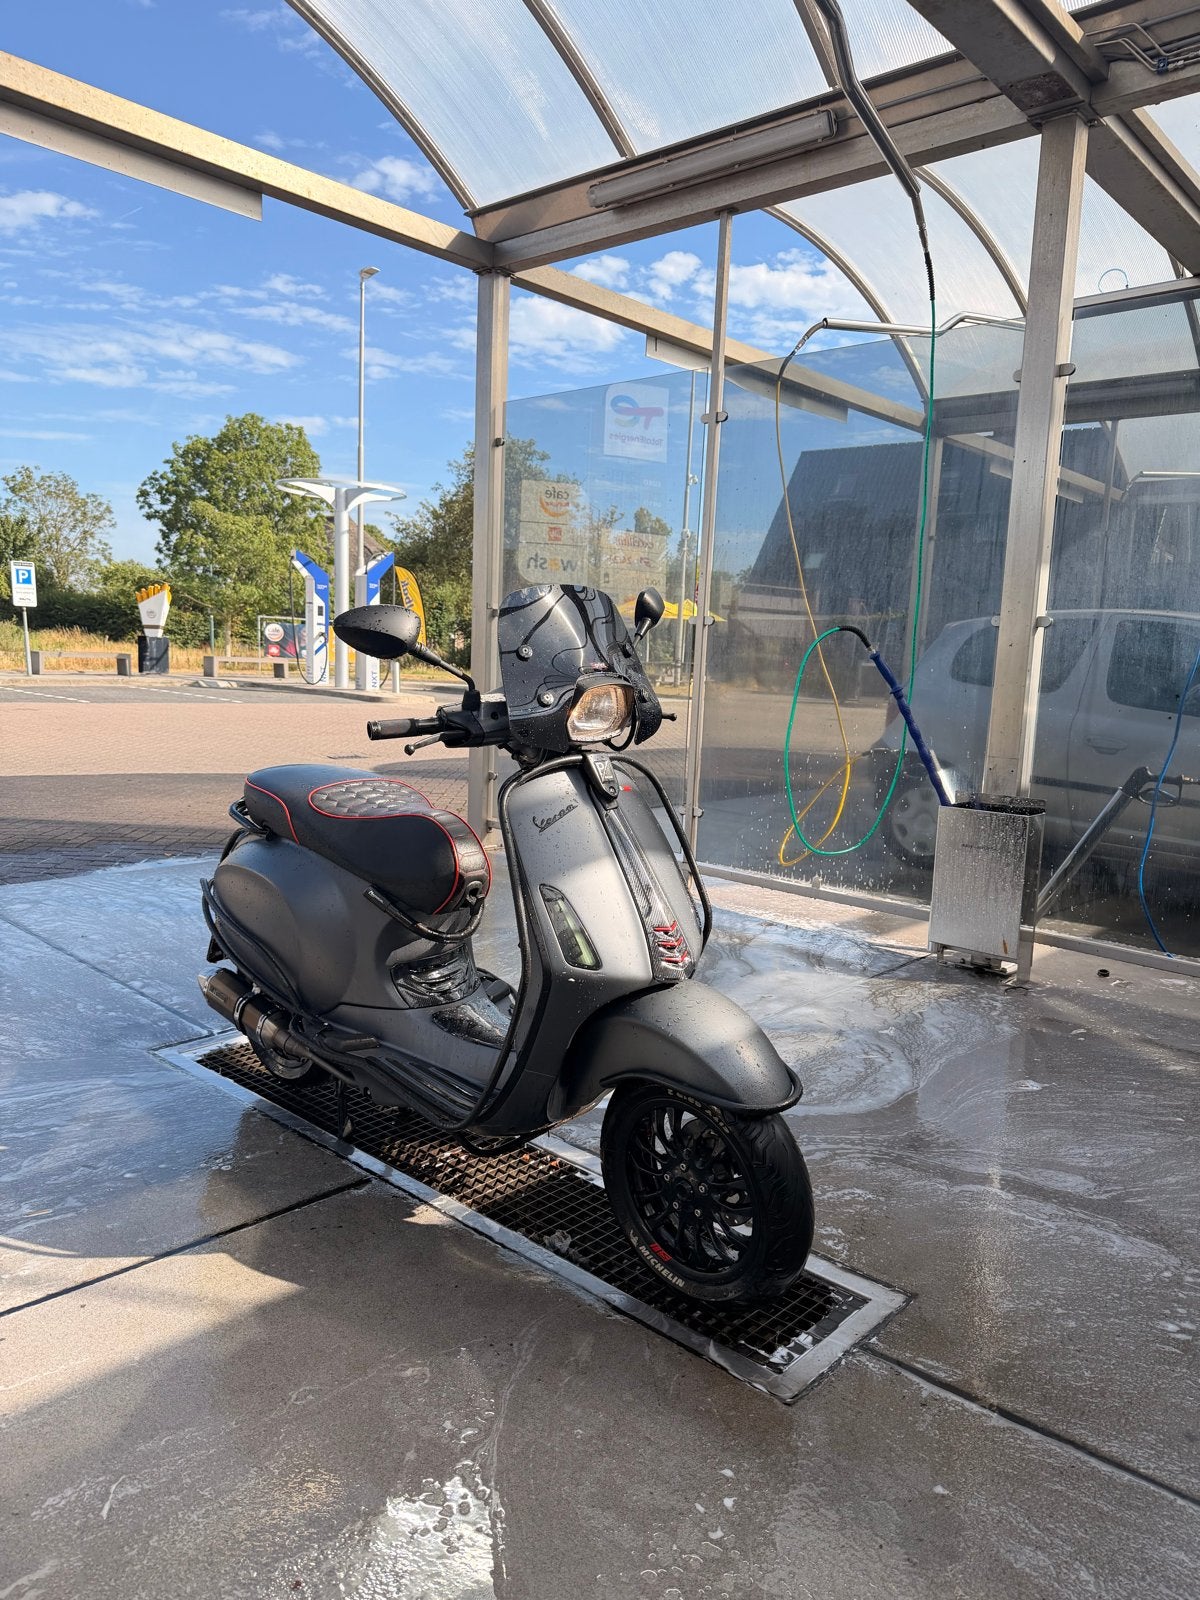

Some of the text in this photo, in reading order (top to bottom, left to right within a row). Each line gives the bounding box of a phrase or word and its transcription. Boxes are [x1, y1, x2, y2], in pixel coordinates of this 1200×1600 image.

[18, 570, 29, 583] P
[532, 804, 579, 834] Vespa
[639, 1245, 686, 1288] MICHELIN
